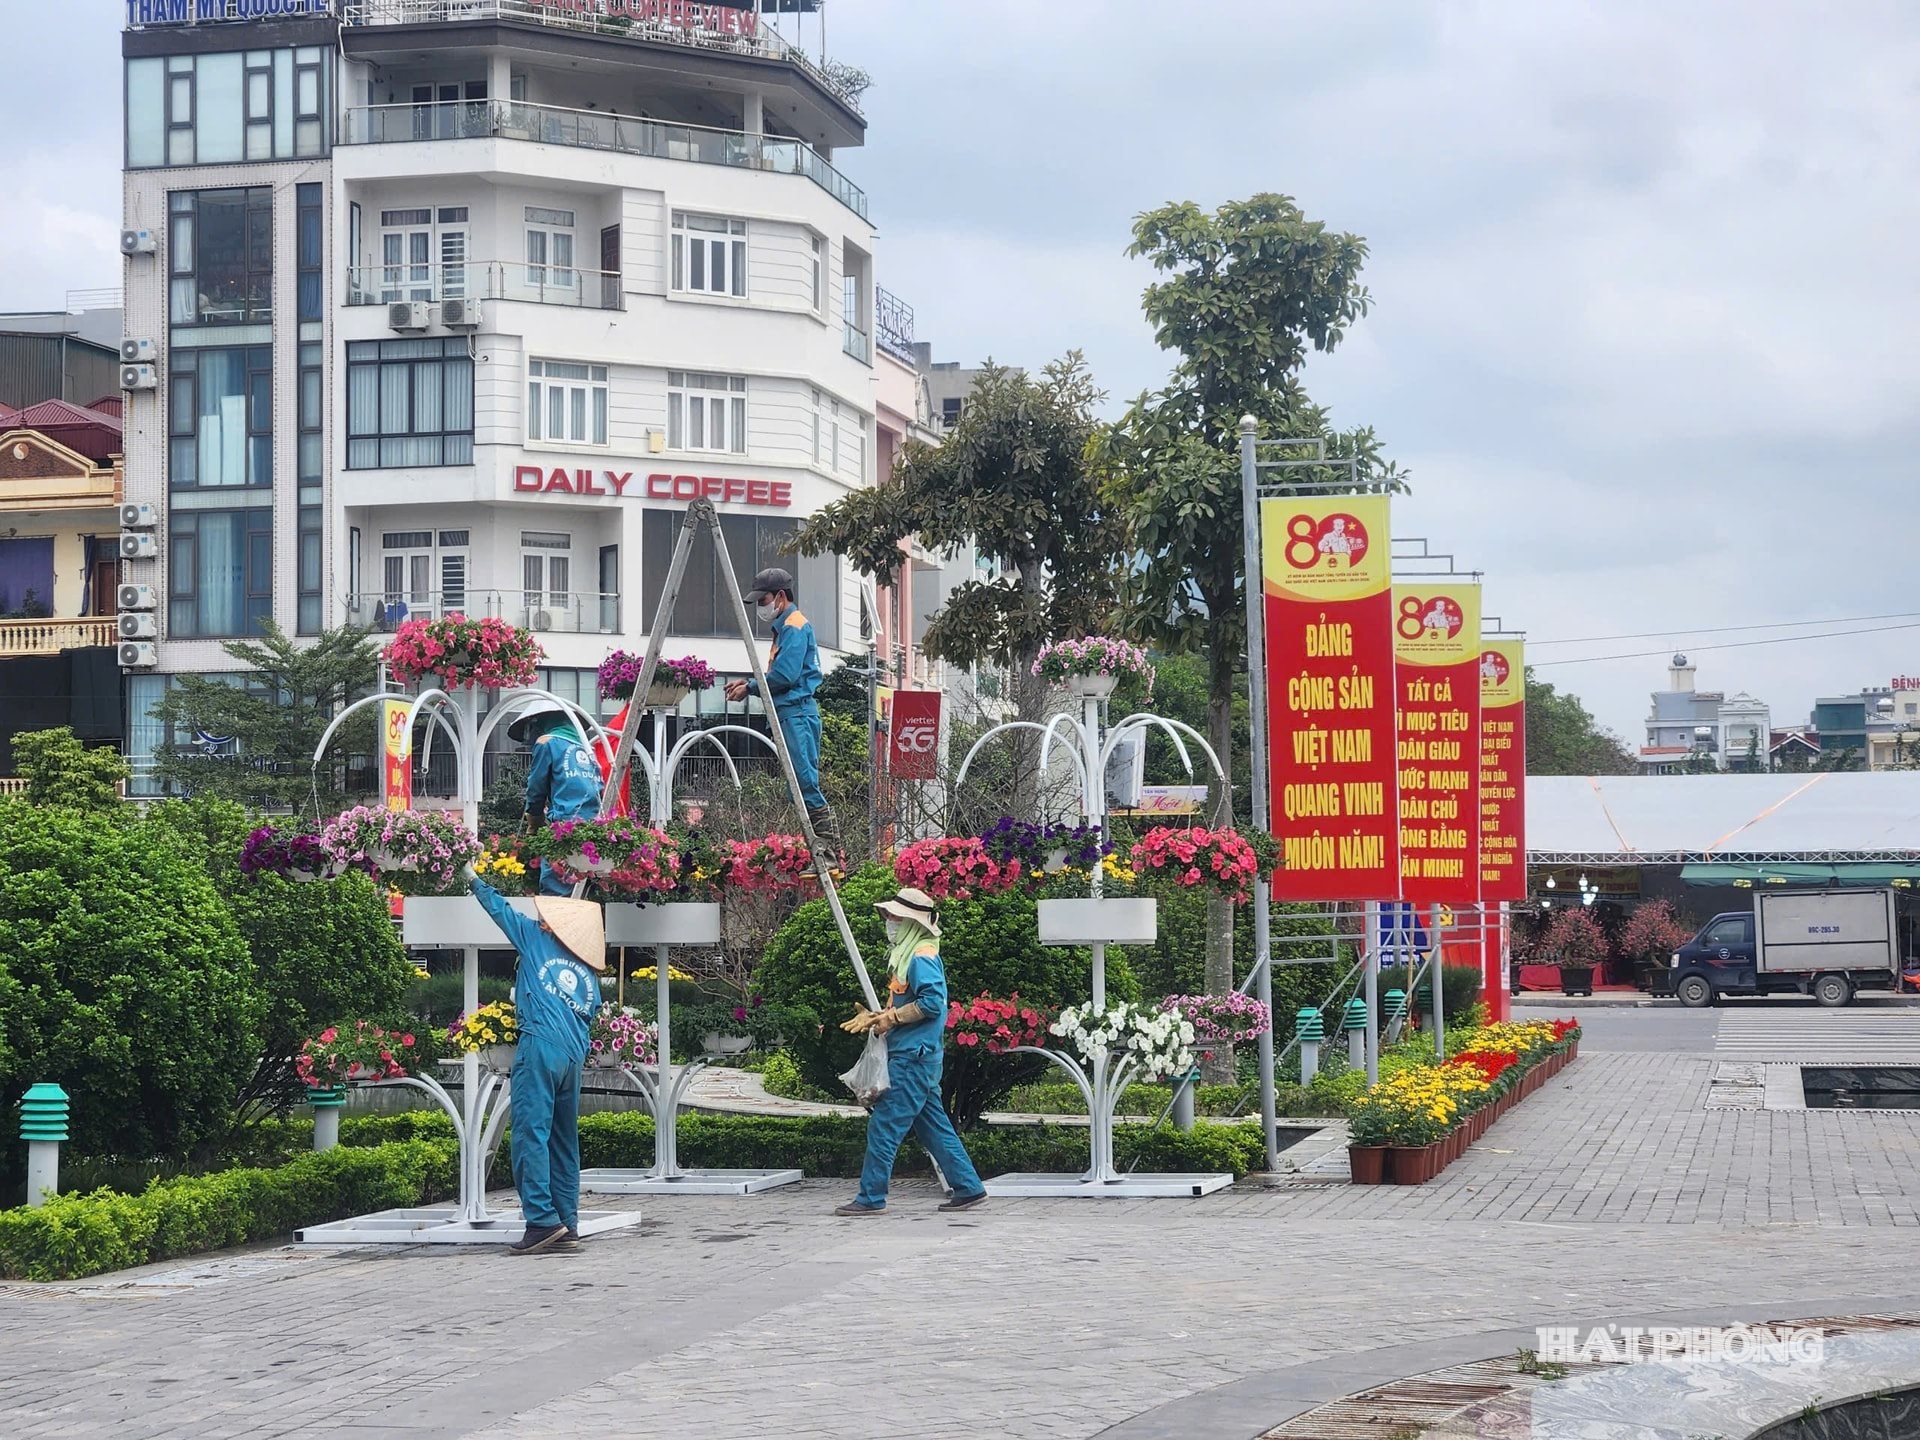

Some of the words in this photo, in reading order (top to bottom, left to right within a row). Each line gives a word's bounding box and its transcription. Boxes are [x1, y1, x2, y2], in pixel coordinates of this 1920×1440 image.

[514, 466, 633, 496] DAILY
[647, 474, 792, 506] COFFEE
[1306, 613, 1353, 657] ĐẢNG
[1288, 671, 1334, 718] CỘNG
[1339, 665, 1374, 710] SẢN
[1407, 676, 1431, 702] TẤT
[1433, 677, 1452, 702] CẢ
[1406, 712, 1436, 735] MỤC
[1439, 709, 1468, 731] TIÊU
[1497, 721, 1514, 733] NAM
[898, 727, 936, 753] 5G
[1292, 724, 1328, 771] VIỆT
[1332, 729, 1372, 763] NAM
[1398, 738, 1425, 760] DÂN
[1429, 738, 1460, 760] GIÀU
[1399, 766, 1425, 790] ƯỚC
[1429, 771, 1469, 794] MẠNH
[1284, 783, 1340, 821] QUANG
[1344, 782, 1384, 816] VINH
[1400, 796, 1427, 819] DÂN
[1431, 794, 1458, 819] CHỦ
[1400, 825, 1427, 849] ÔNG
[1430, 823, 1467, 849] BẰNG
[1285, 829, 1335, 870] MUÔN
[1339, 829, 1385, 869] NĂM!
[1400, 854, 1420, 878] ĂN
[1423, 858, 1464, 878] MINH!
